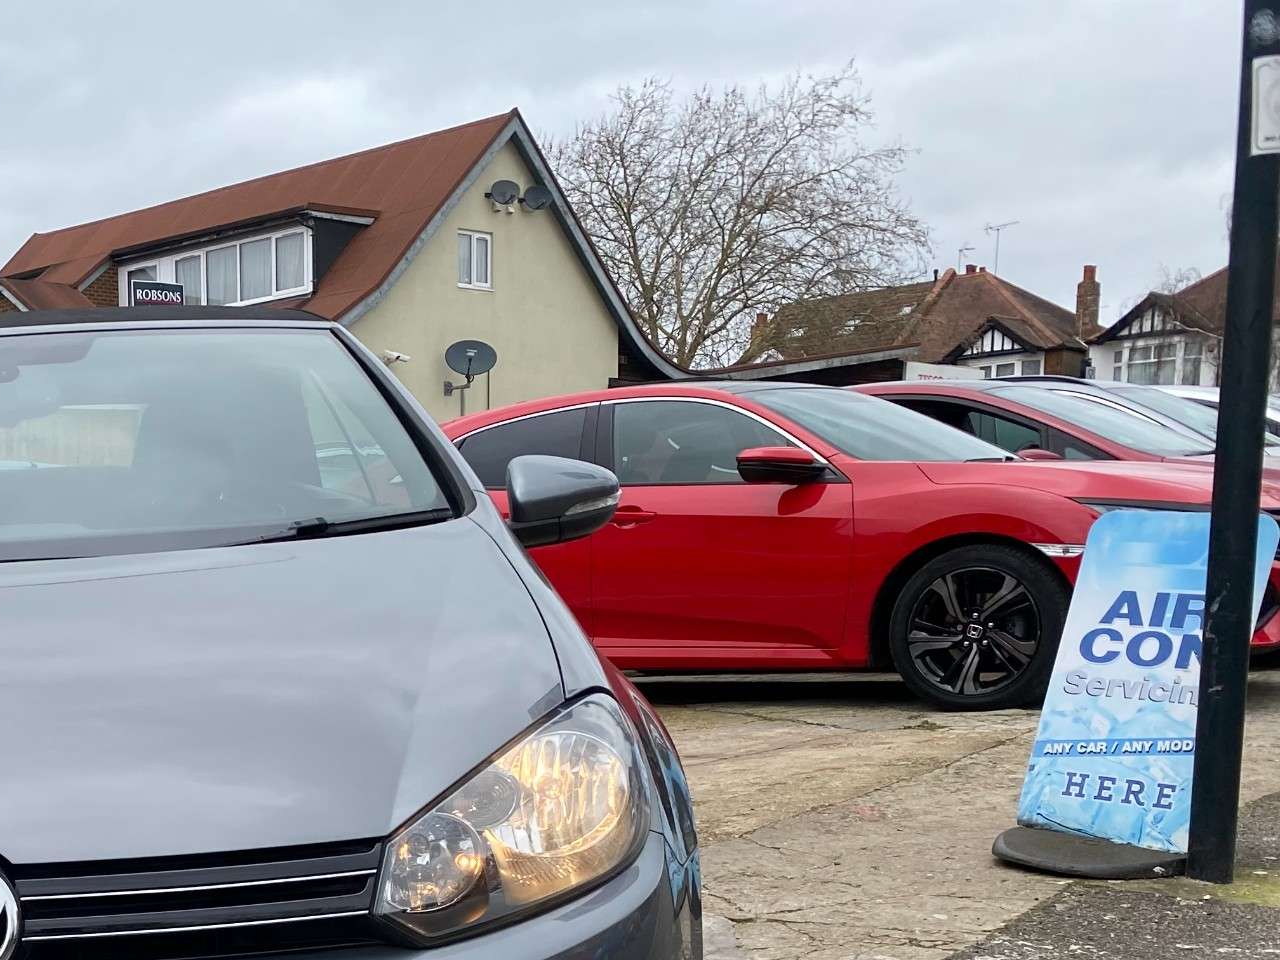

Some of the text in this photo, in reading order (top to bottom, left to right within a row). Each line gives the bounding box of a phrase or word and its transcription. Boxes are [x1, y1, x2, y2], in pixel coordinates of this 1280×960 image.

[136, 288, 182, 303] ROBSONS
[1098, 590, 1206, 630] AIR
[1079, 627, 1203, 669] CON
[1043, 742, 1074, 756] ANY
[1076, 741, 1108, 755] CAR
[1122, 740, 1154, 754] ANY
[1062, 771, 1177, 810] HERE
